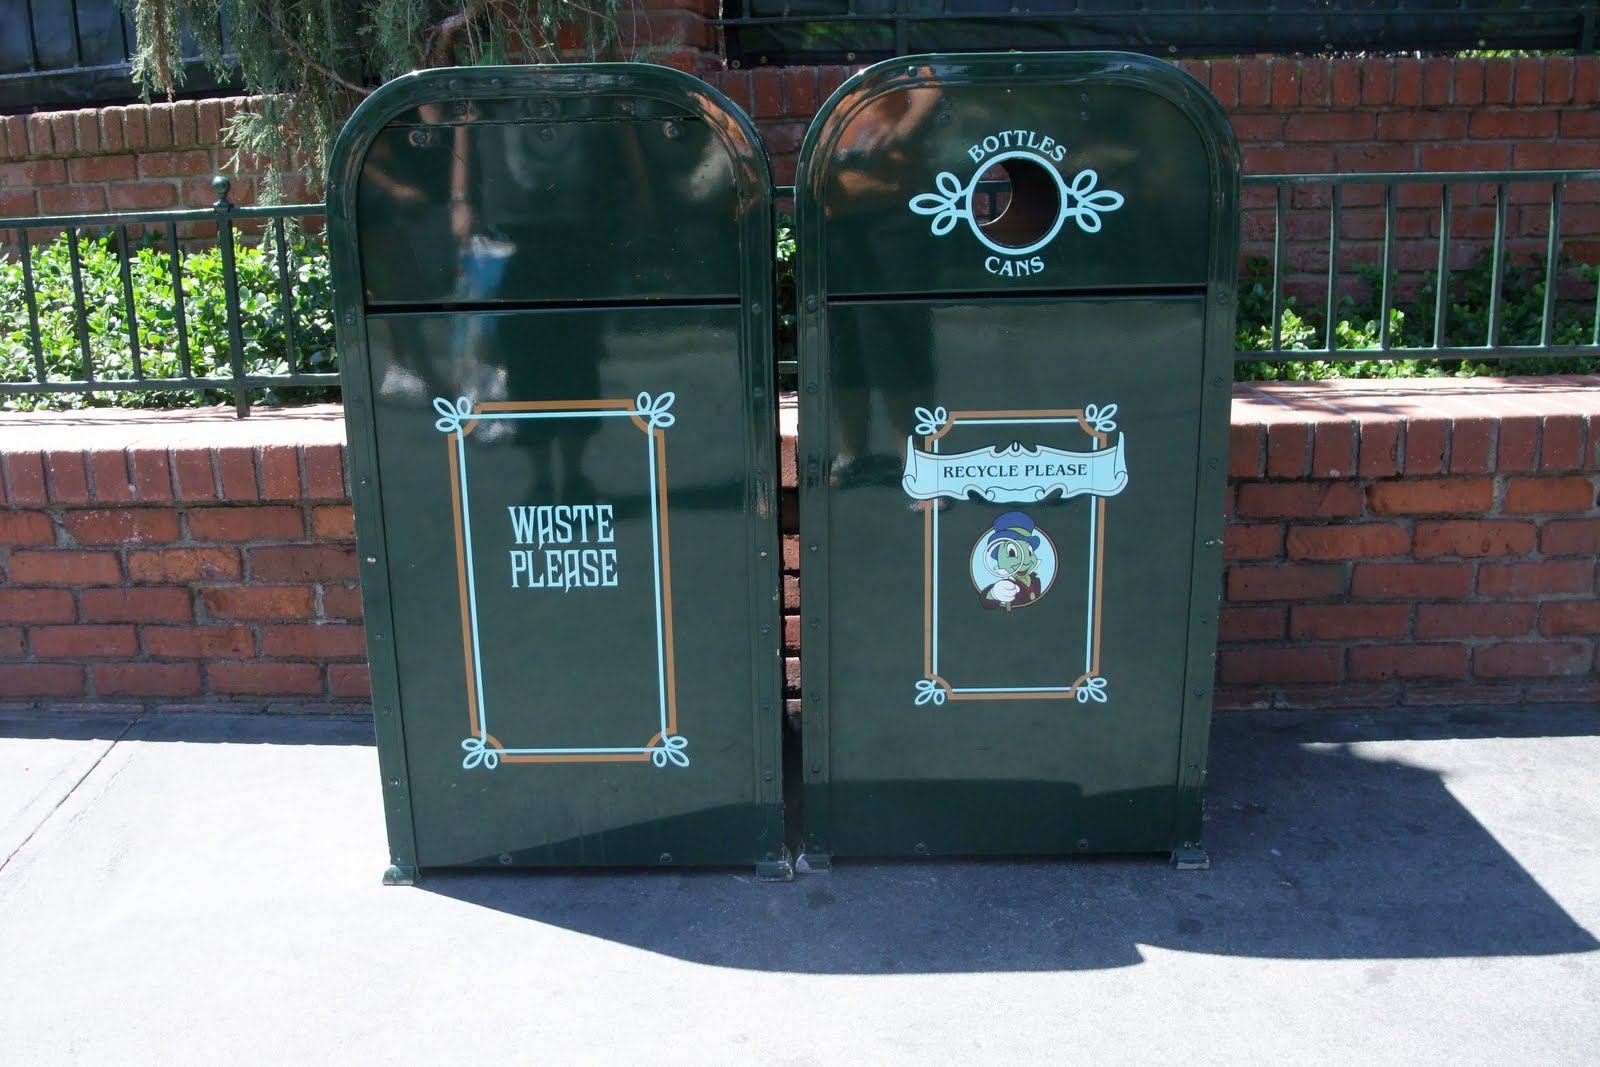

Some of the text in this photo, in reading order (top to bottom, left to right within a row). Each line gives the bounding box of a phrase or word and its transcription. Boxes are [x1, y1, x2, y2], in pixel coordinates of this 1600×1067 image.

[967, 129, 1067, 164] BOTTLES
[984, 255, 1045, 277] CANS
[943, 463, 1088, 478] RECYCLE PLEASE
[507, 504, 615, 550] WASTE
[508, 548, 619, 593] PLEASE
